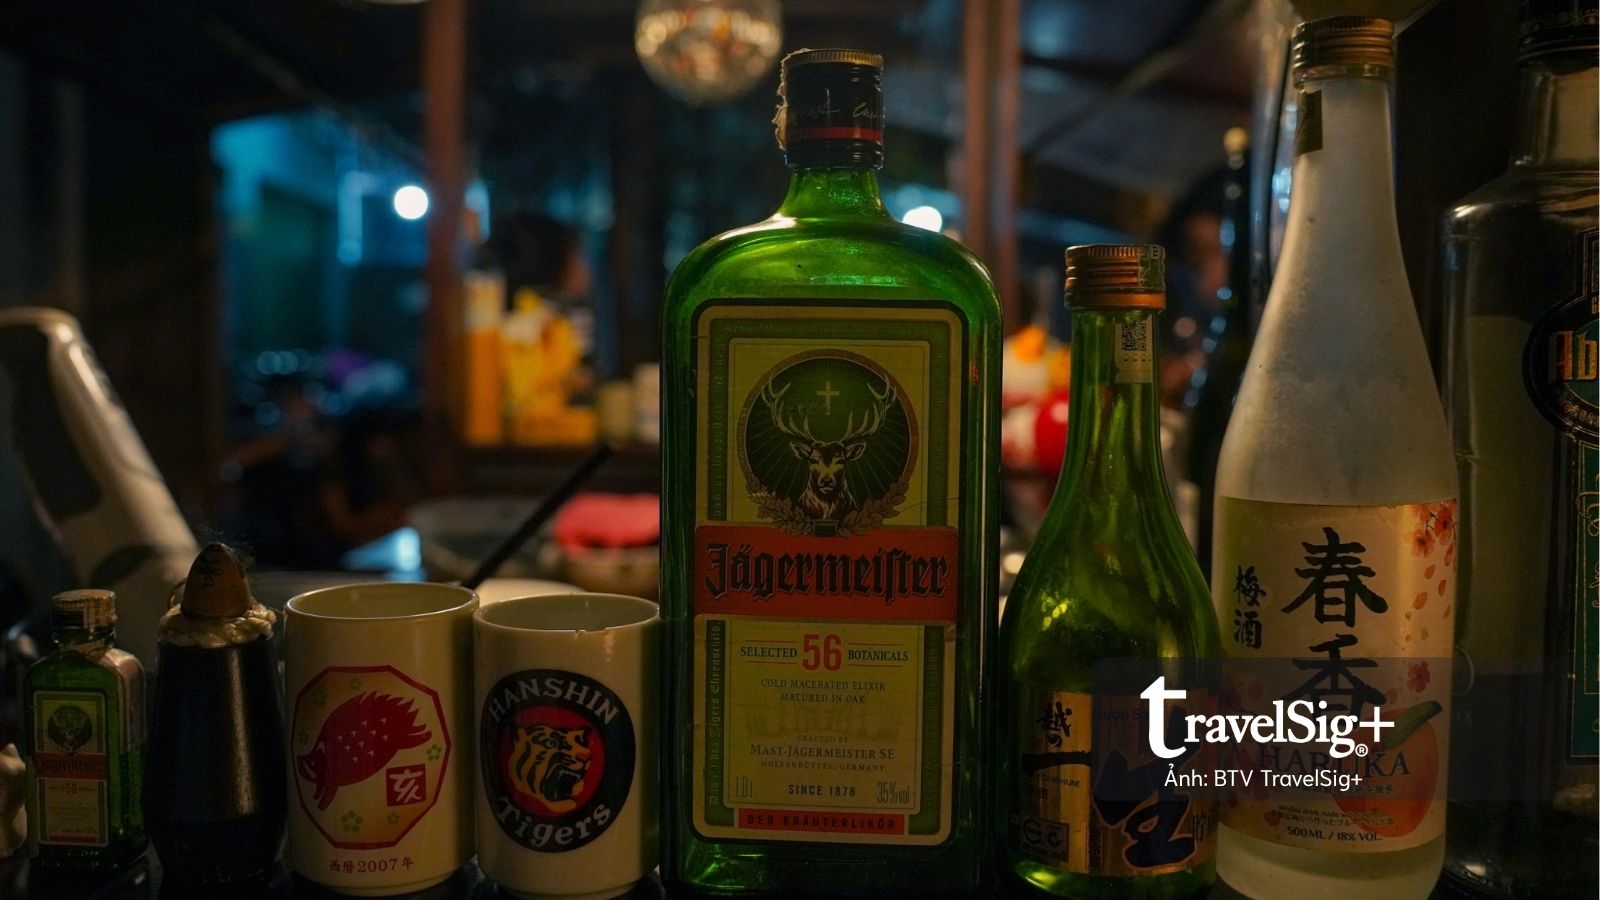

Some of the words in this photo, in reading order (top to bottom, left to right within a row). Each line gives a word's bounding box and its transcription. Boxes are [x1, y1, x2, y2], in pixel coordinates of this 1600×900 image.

[740, 646, 797, 658] SELECTED
[802, 633, 842, 672] 56
[848, 650, 909, 662] BOTANICALS
[761, 678, 787, 688] COLD
[790, 679, 849, 690] MACERATED
[852, 681, 886, 691] ELIXIR
[489, 677, 621, 725] HANSHIN
[780, 693, 828, 703] MATURED
[832, 694, 843, 703] IN
[846, 695, 865, 704] OAK
[879, 748, 895, 759] SE
[1258, 743, 1412, 778] HARUKA
[787, 784, 823, 796] SINCE
[829, 785, 856, 797] 1878
[498, 796, 612, 847] Tigers
[747, 814, 776, 825] DER
[783, 814, 896, 831] KRÄUTERLIKÖR
[1337, 832, 1356, 841] 18%
